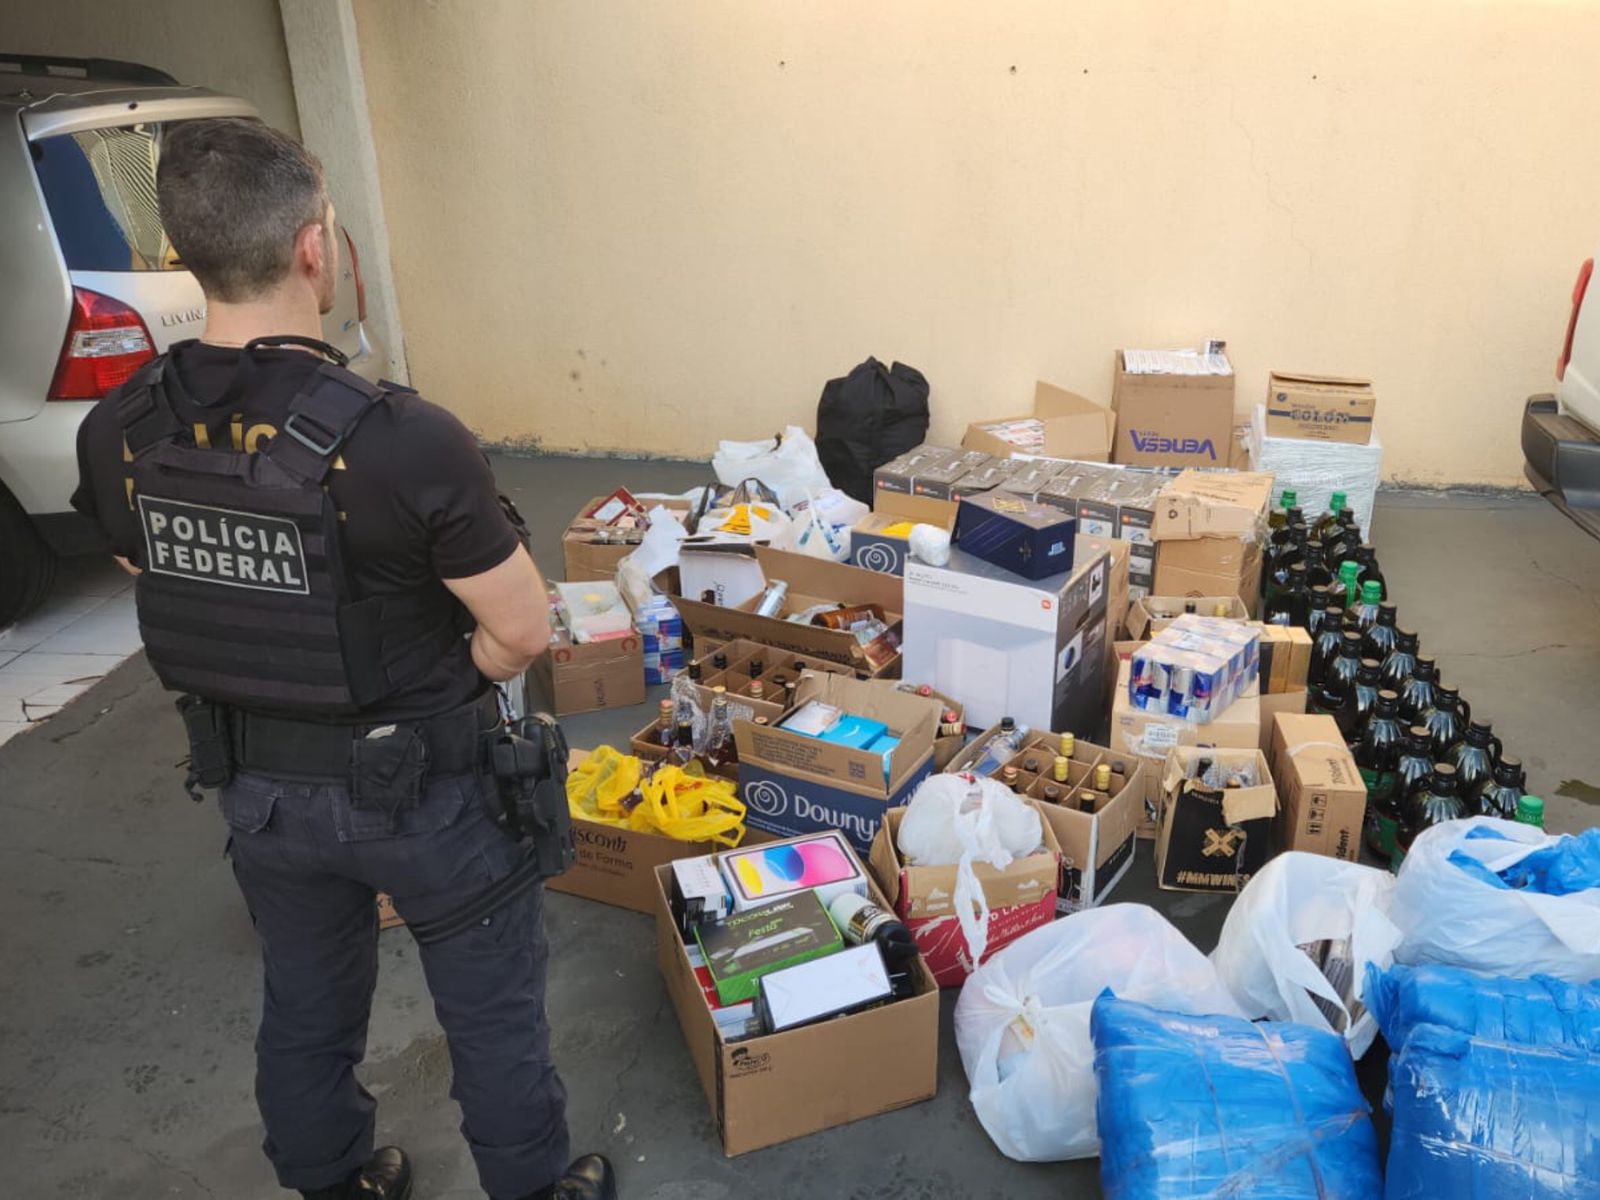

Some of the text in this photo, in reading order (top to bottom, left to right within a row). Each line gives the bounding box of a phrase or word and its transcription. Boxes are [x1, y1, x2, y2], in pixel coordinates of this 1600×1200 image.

[149, 511, 296, 556] POLÍCIA
[154, 540, 301, 586] FEDERAL
[794, 795, 875, 842] Downy
